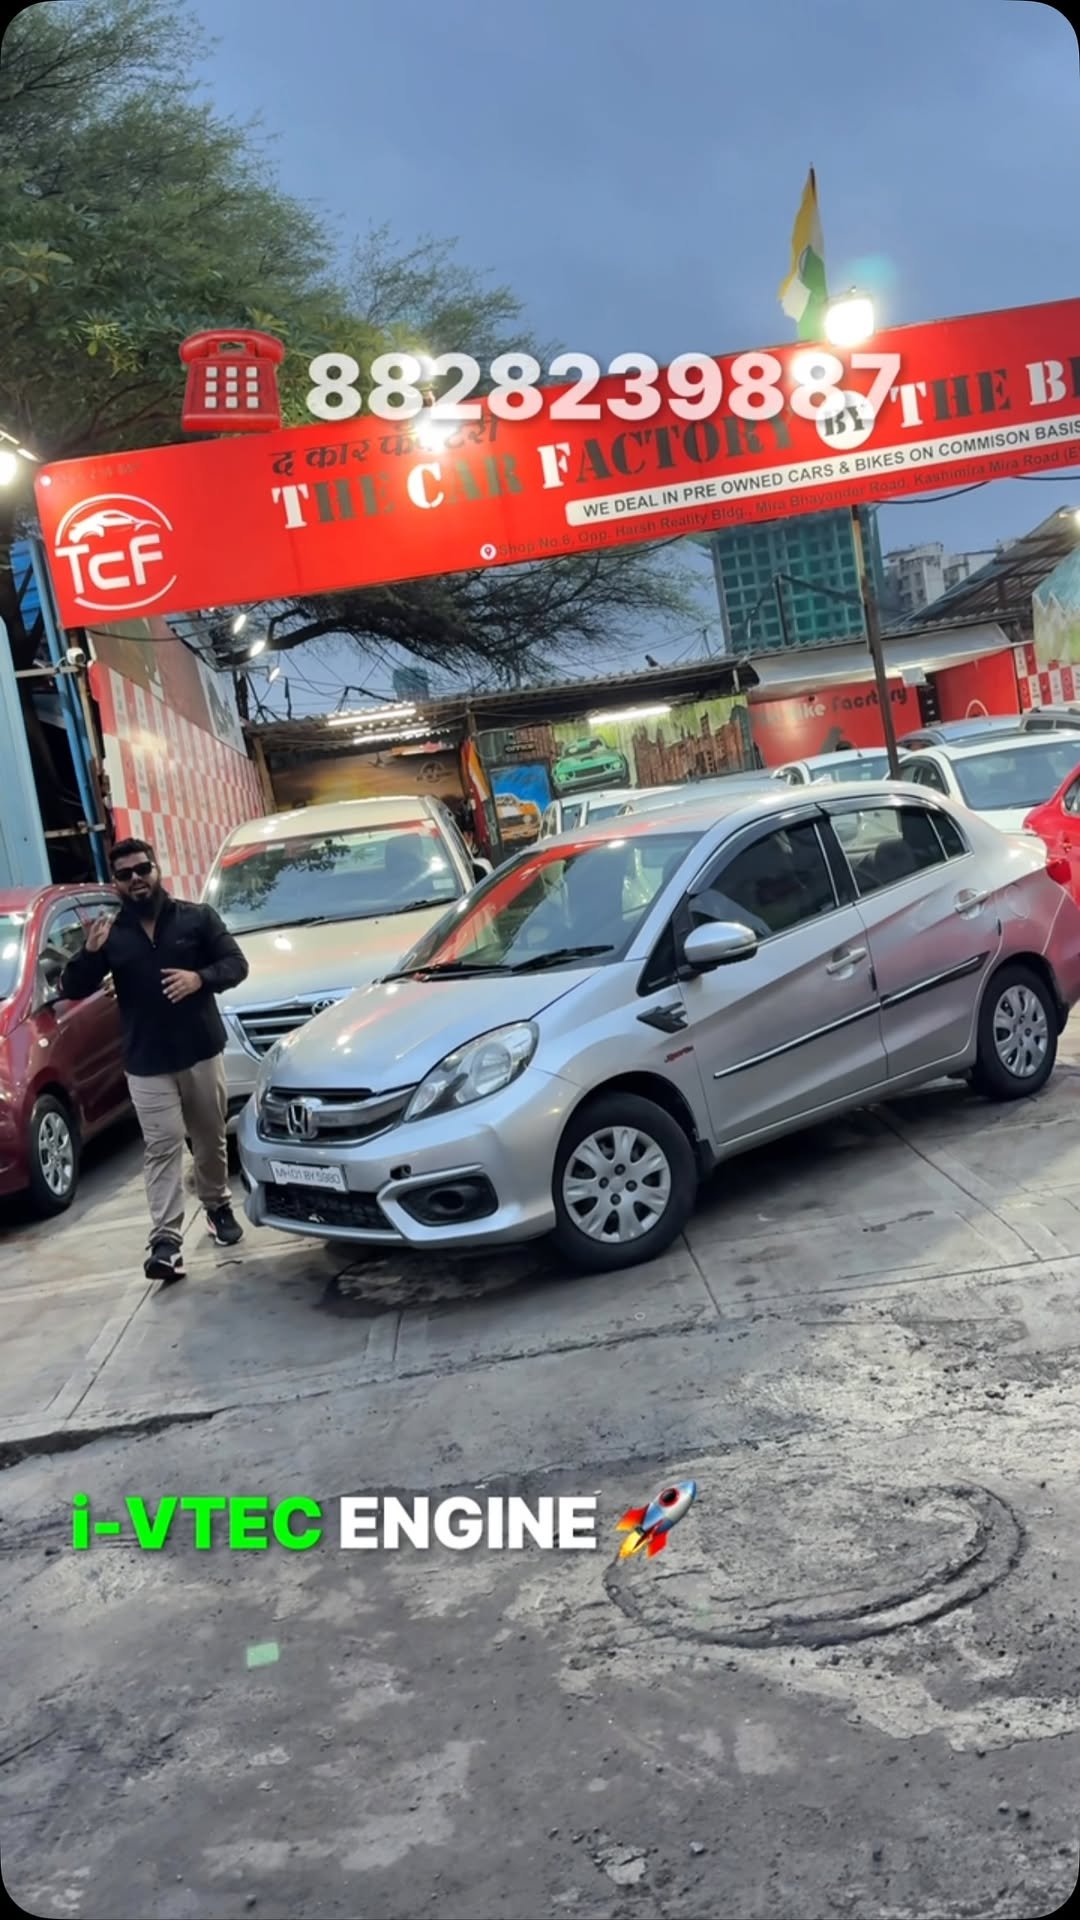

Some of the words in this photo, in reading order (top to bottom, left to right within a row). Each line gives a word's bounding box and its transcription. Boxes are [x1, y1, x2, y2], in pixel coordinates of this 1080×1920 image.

[271, 473, 396, 529] THE
[407, 453, 525, 510] CAR
[537, 412, 795, 489] FACTORY
[823, 402, 868, 437] BY
[890, 369, 1011, 428] THE
[583, 503, 609, 518] WE
[615, 492, 659, 513] DEAL
[662, 490, 679, 505] IN
[683, 484, 717, 501] PRE
[721, 472, 783, 494] OWNED
[788, 464, 834, 483] CARS
[839, 461, 850, 475] &
[855, 451, 905, 472] BIKES
[909, 446, 934, 462] ON
[938, 428, 1030, 457] COMMISON
[615, 521, 656, 537] Harsh
[660, 511, 708, 529] Reality
[756, 499, 786, 513] Mira
[989, 457, 1019, 473] Mira
[1024, 448, 1060, 466] Road
